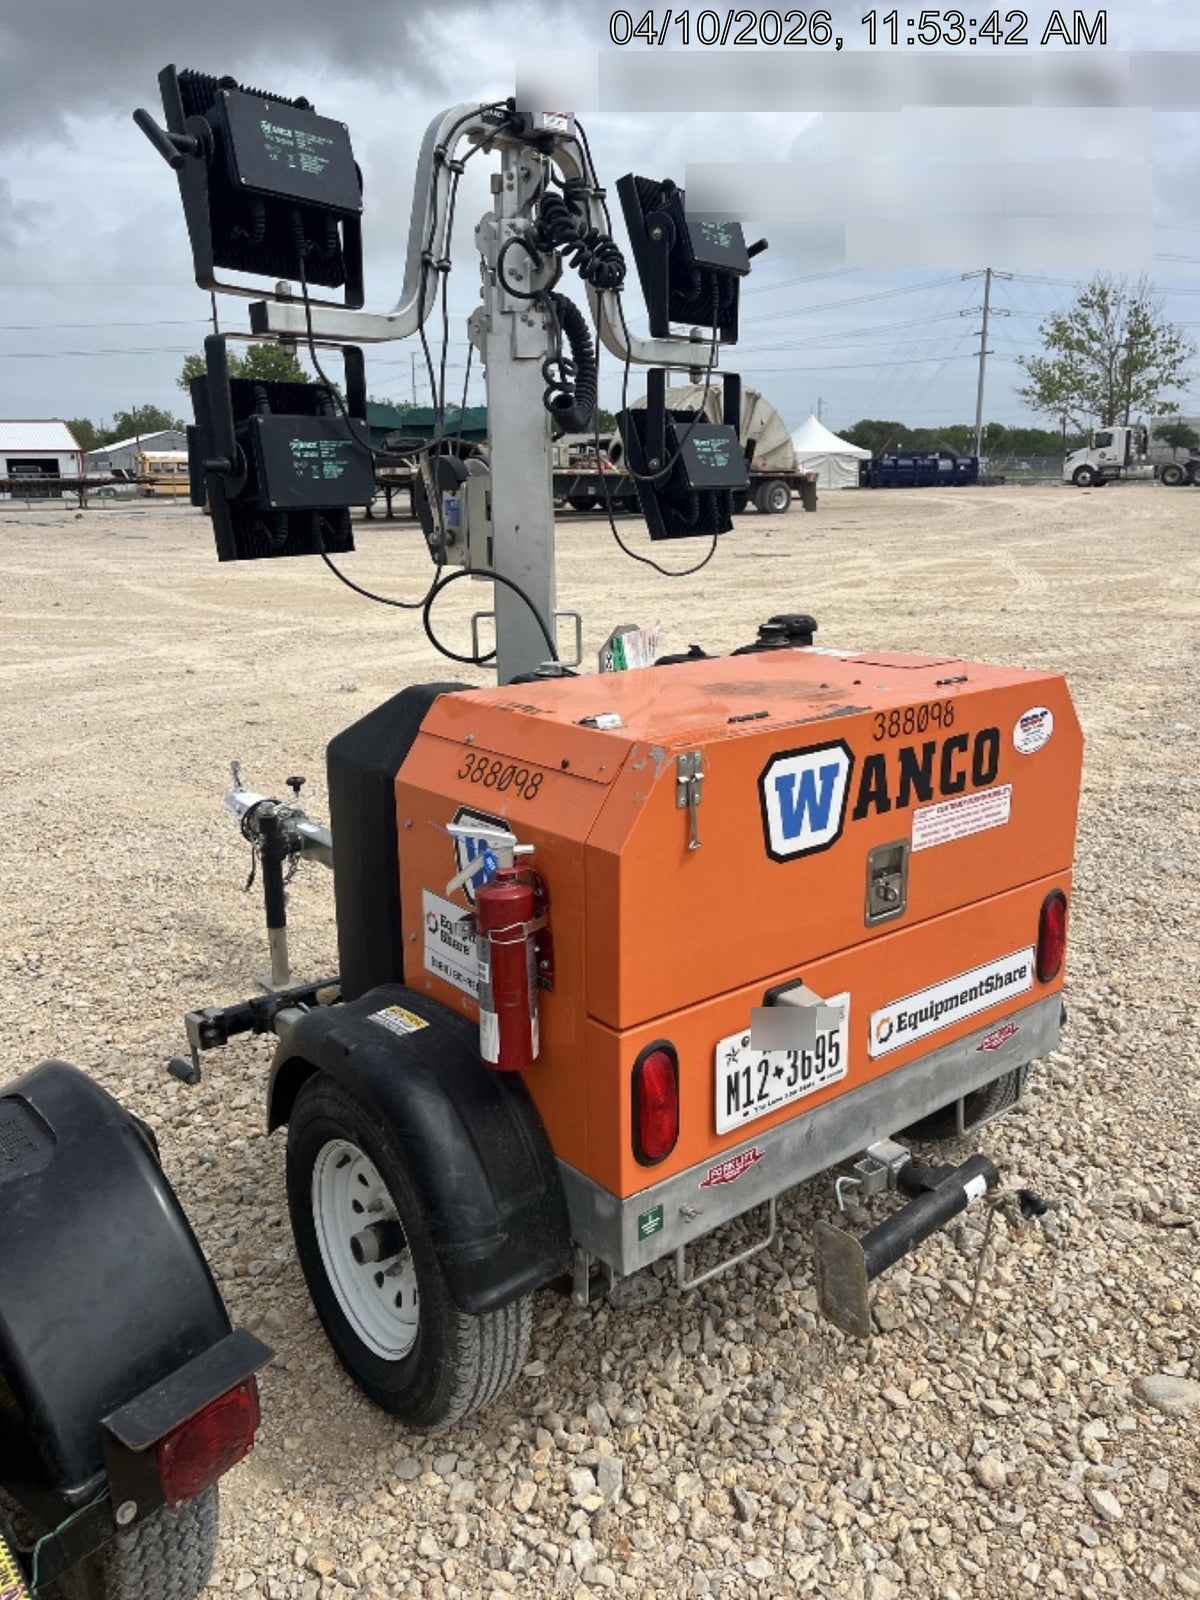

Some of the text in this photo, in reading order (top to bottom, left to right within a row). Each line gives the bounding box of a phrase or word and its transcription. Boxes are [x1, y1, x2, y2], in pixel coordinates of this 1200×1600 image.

[873, 700, 954, 741] 388098
[457, 753, 543, 800] 388098
[773, 726, 1001, 841] WANCO
[895, 964, 1027, 1033] EquipmentShare
